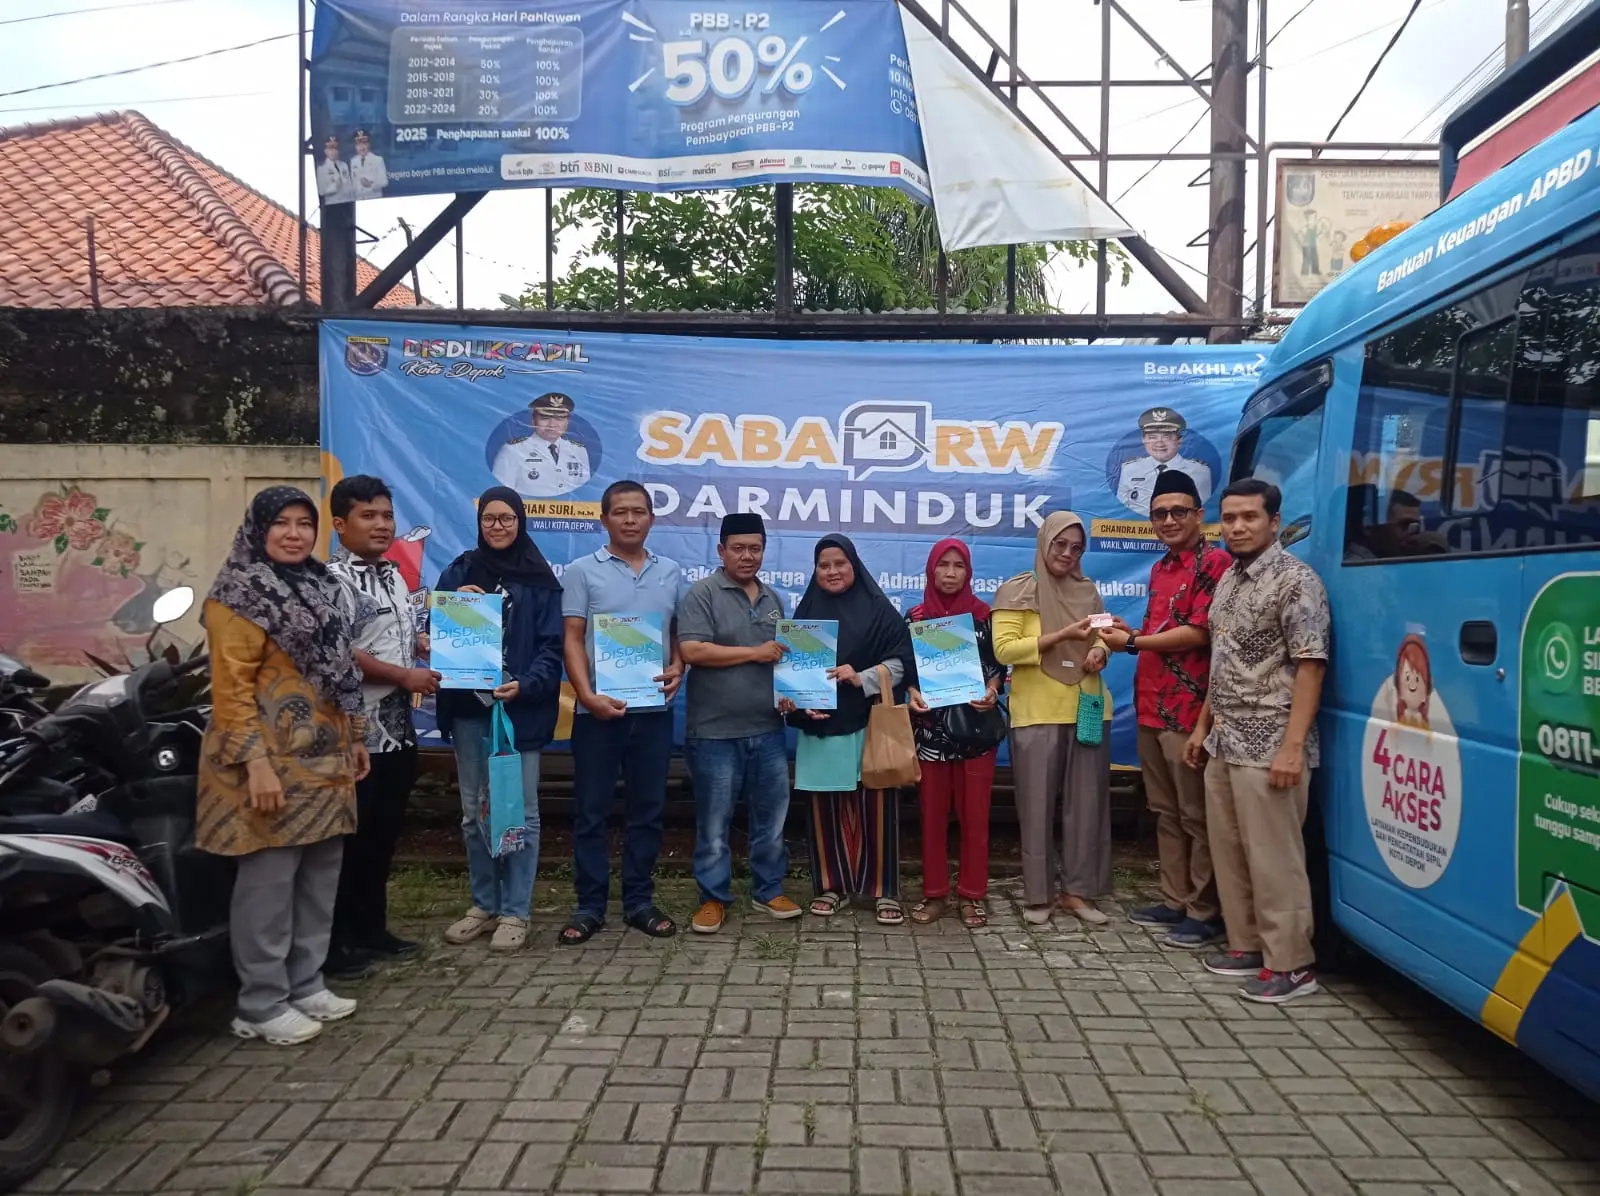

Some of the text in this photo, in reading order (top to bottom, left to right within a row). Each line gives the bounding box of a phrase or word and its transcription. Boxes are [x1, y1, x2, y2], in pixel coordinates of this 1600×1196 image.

[400, 11, 581, 25] Dalam Rangka Hari Pahlawan
[690, 12, 730, 28] PBB
[745, 12, 770, 28] P2
[408, 57, 561, 71] 2012-2014 50% 100%
[662, 36, 813, 103] 50%
[479, 74, 500, 85] 40%
[535, 76, 560, 87] 100%
[535, 91, 559, 101] 100%
[404, 103, 558, 116] 2022-2024 20% 100%
[680, 109, 800, 133] Program Pengurangan
[396, 127, 569, 141] 2025 Penghapusan sanksi 100%
[686, 121, 795, 146] Pembayaran PBB-P2
[560, 160, 580, 173] btn
[594, 163, 613, 174] BNI
[1376, 148, 1592, 293] Bantuan Keuangan APBD
[403, 338, 590, 364] DISDUKCAPIL
[400, 360, 505, 383] Kota Depok
[1144, 358, 1262, 377] BerAKHLAK
[641, 413, 1062, 472] SABA RW
[644, 483, 1052, 529] DARMINDUK
[533, 520, 595, 531] WALI KOTA DEPOK
[1100, 524, 1137, 535] CHANDRA
[1100, 540, 1121, 550] WAKIL
[1122, 541, 1140, 551] WALI
[1140, 541, 1157, 551] KOTA
[1372, 729, 1447, 800] 4 CARA
[1381, 780, 1442, 832] AKSES
[1544, 793, 1578, 820] Cukup
[1534, 812, 1572, 840] tunggu
[1397, 828, 1448, 857] KEPENDUDUKAN
